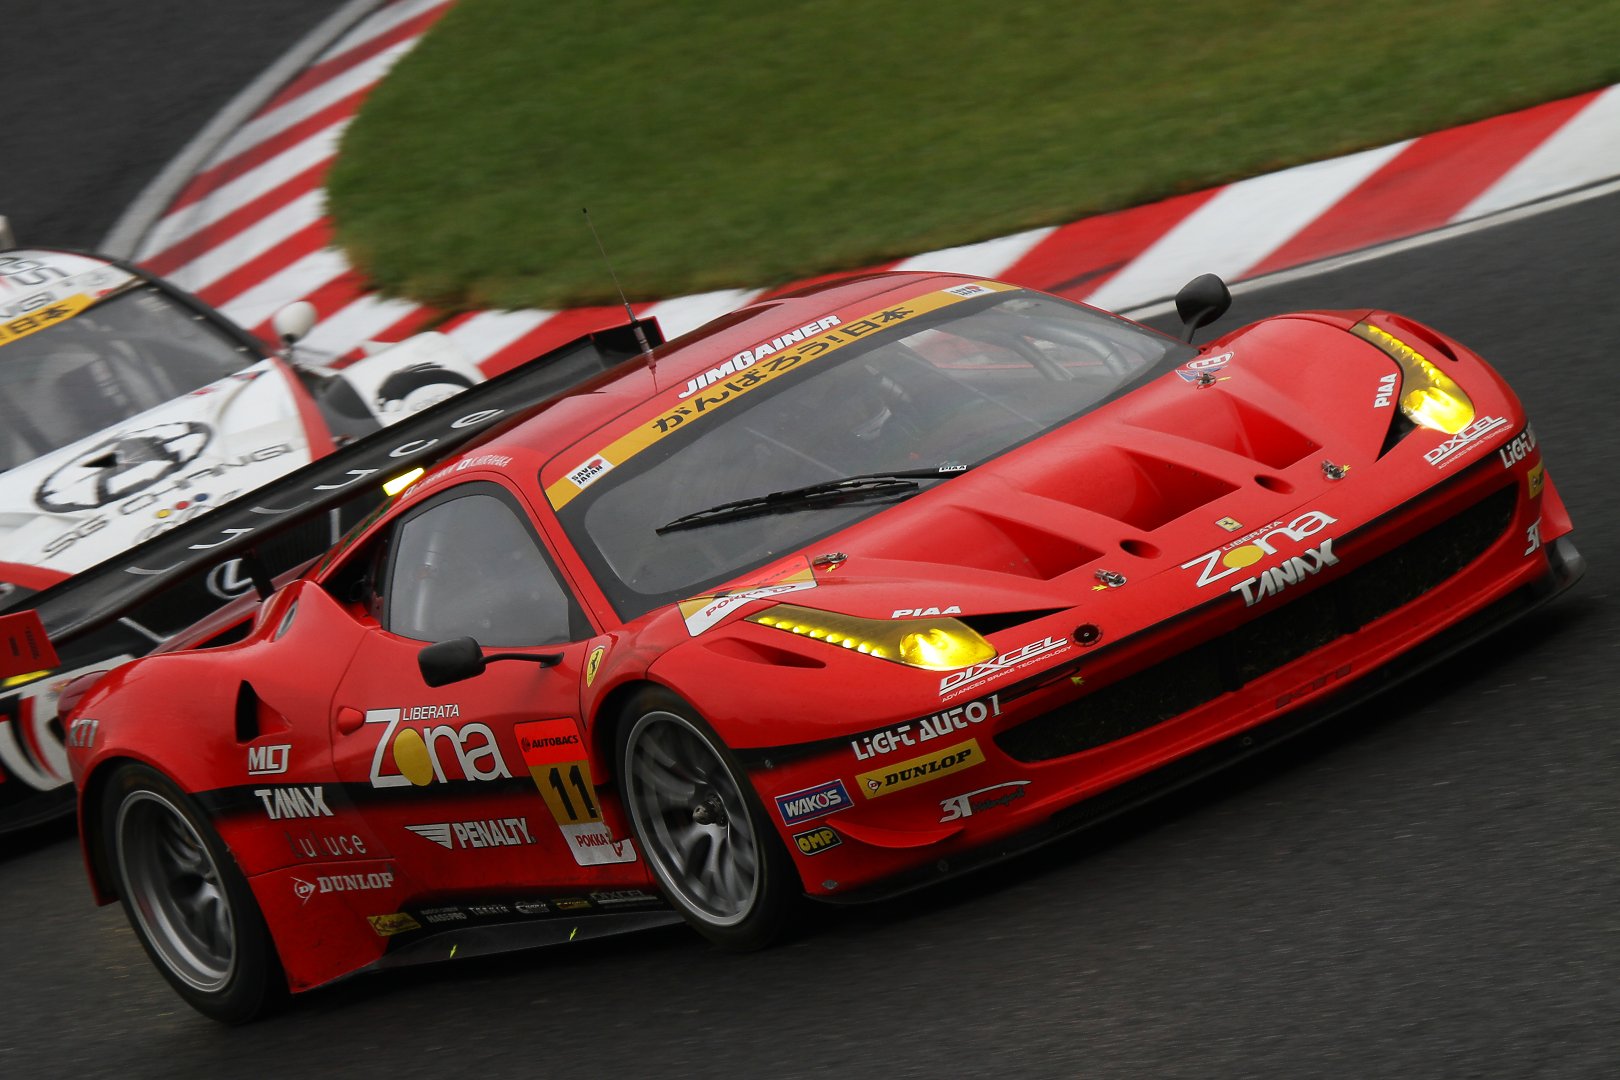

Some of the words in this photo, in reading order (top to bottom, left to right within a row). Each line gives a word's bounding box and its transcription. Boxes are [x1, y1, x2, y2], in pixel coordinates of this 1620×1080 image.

[677, 315, 842, 399] JIMGAINER
[1373, 372, 1397, 408] PIAA
[1423, 416, 1507, 466] DIXCEL
[571, 465, 593, 480] SAVE
[577, 465, 603, 484] JAPAN
[1222, 520, 1283, 551] LIBERATA
[1230, 538, 1340, 607] TANAX
[891, 605, 962, 619] PIAA
[939, 636, 1068, 696] DIXCEL
[942, 679, 986, 702] ADVANCED
[987, 667, 1016, 682] BRAKE
[1016, 645, 1073, 670] TECHNOLOGY
[402, 704, 460, 721] LIBERATA
[920, 701, 988, 742] AUTO
[532, 735, 579, 749] AUTOBACS
[885, 749, 972, 787] DUNLOP
[254, 786, 334, 819] TANAX
[549, 765, 599, 821] 11
[452, 818, 532, 849] PENALTY
[575, 833, 609, 848] POKKA
[797, 830, 833, 853] OMP
[316, 872, 395, 893] DUNLOP
